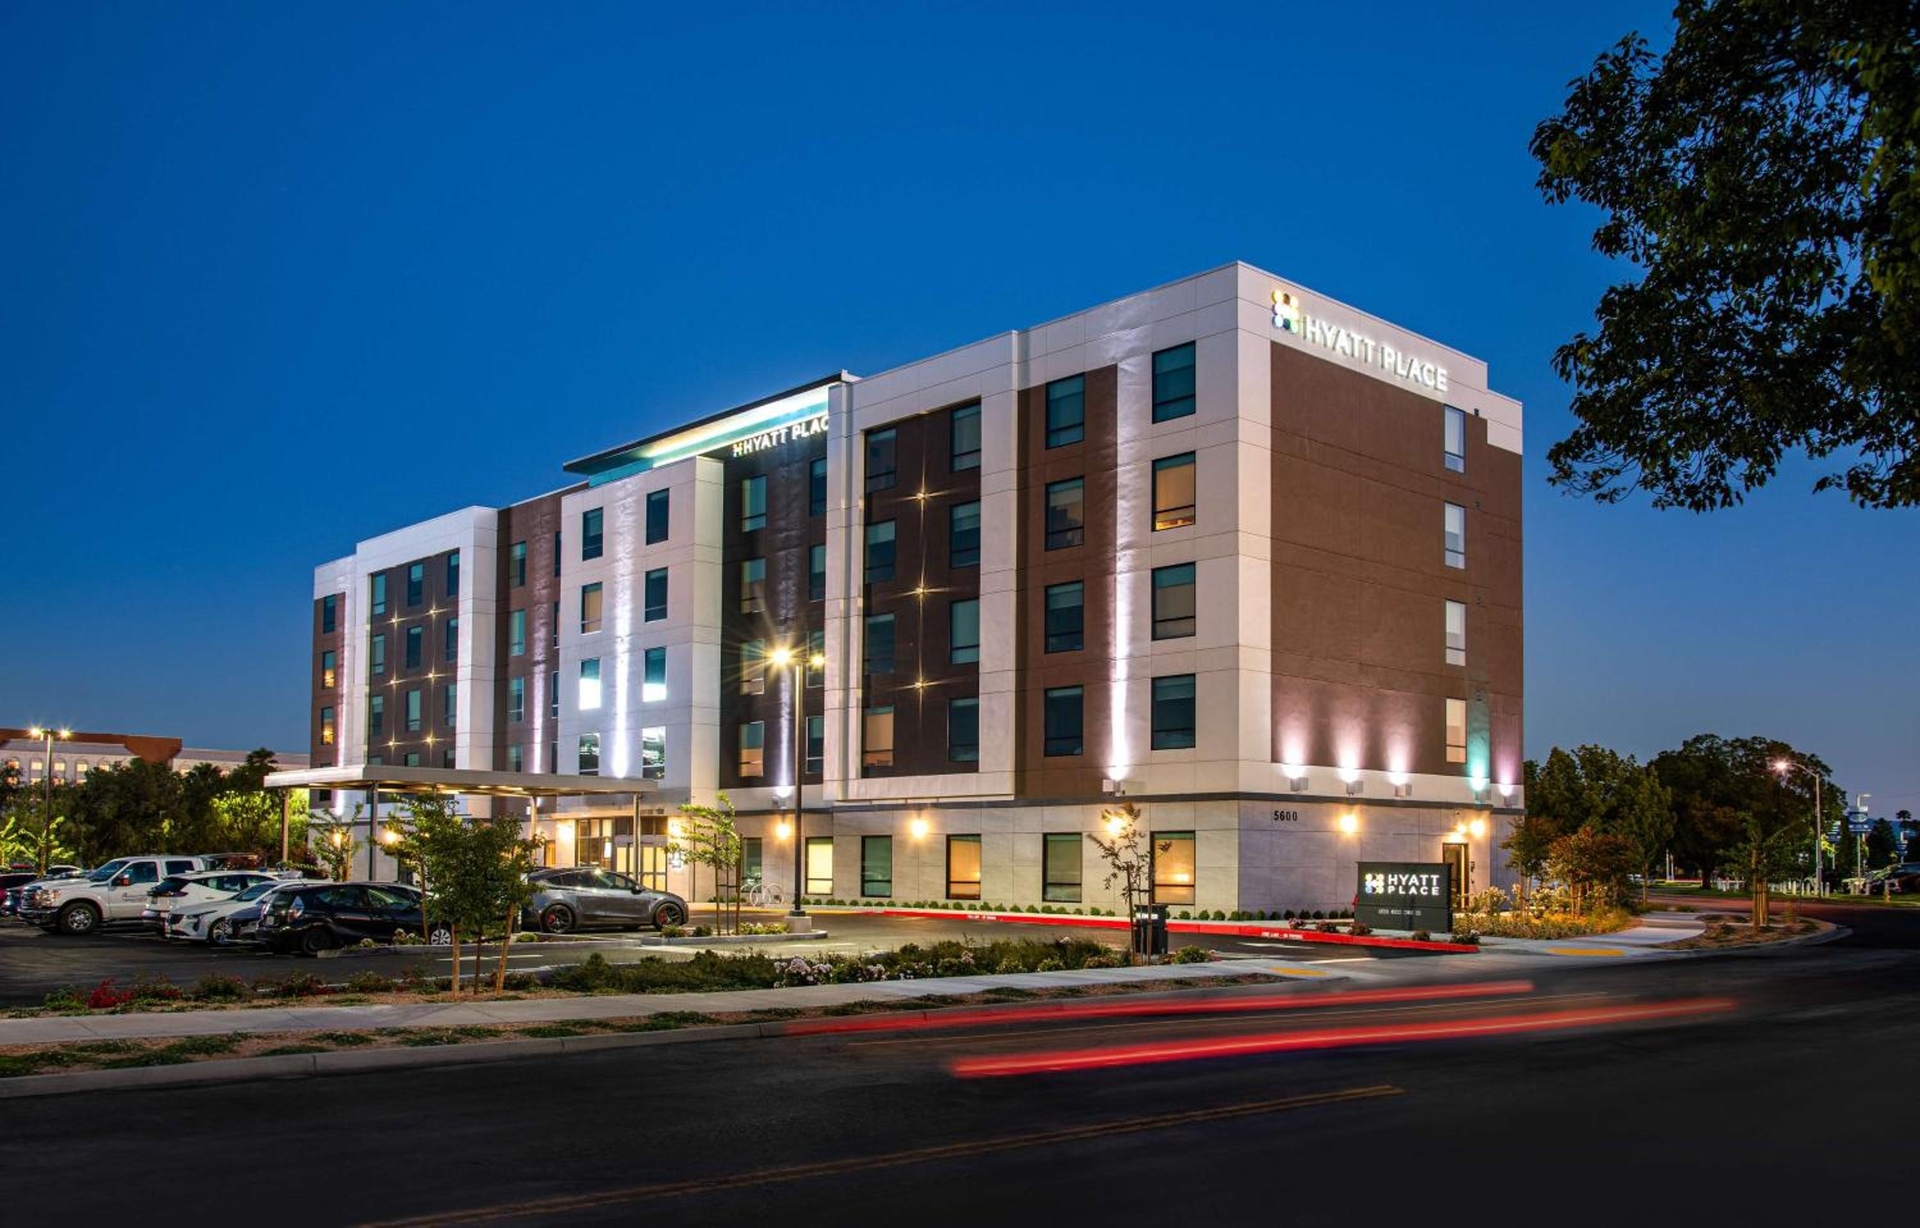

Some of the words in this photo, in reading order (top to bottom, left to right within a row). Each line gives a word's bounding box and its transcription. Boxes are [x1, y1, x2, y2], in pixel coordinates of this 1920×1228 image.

[1303, 315, 1375, 363] HYATT
[1381, 345, 1448, 392] PLACE
[743, 428, 788, 454] HYATT
[1273, 810, 1298, 821] 5600
[1387, 874, 1440, 886] HYATT
[1387, 886, 1440, 896] PLACE
